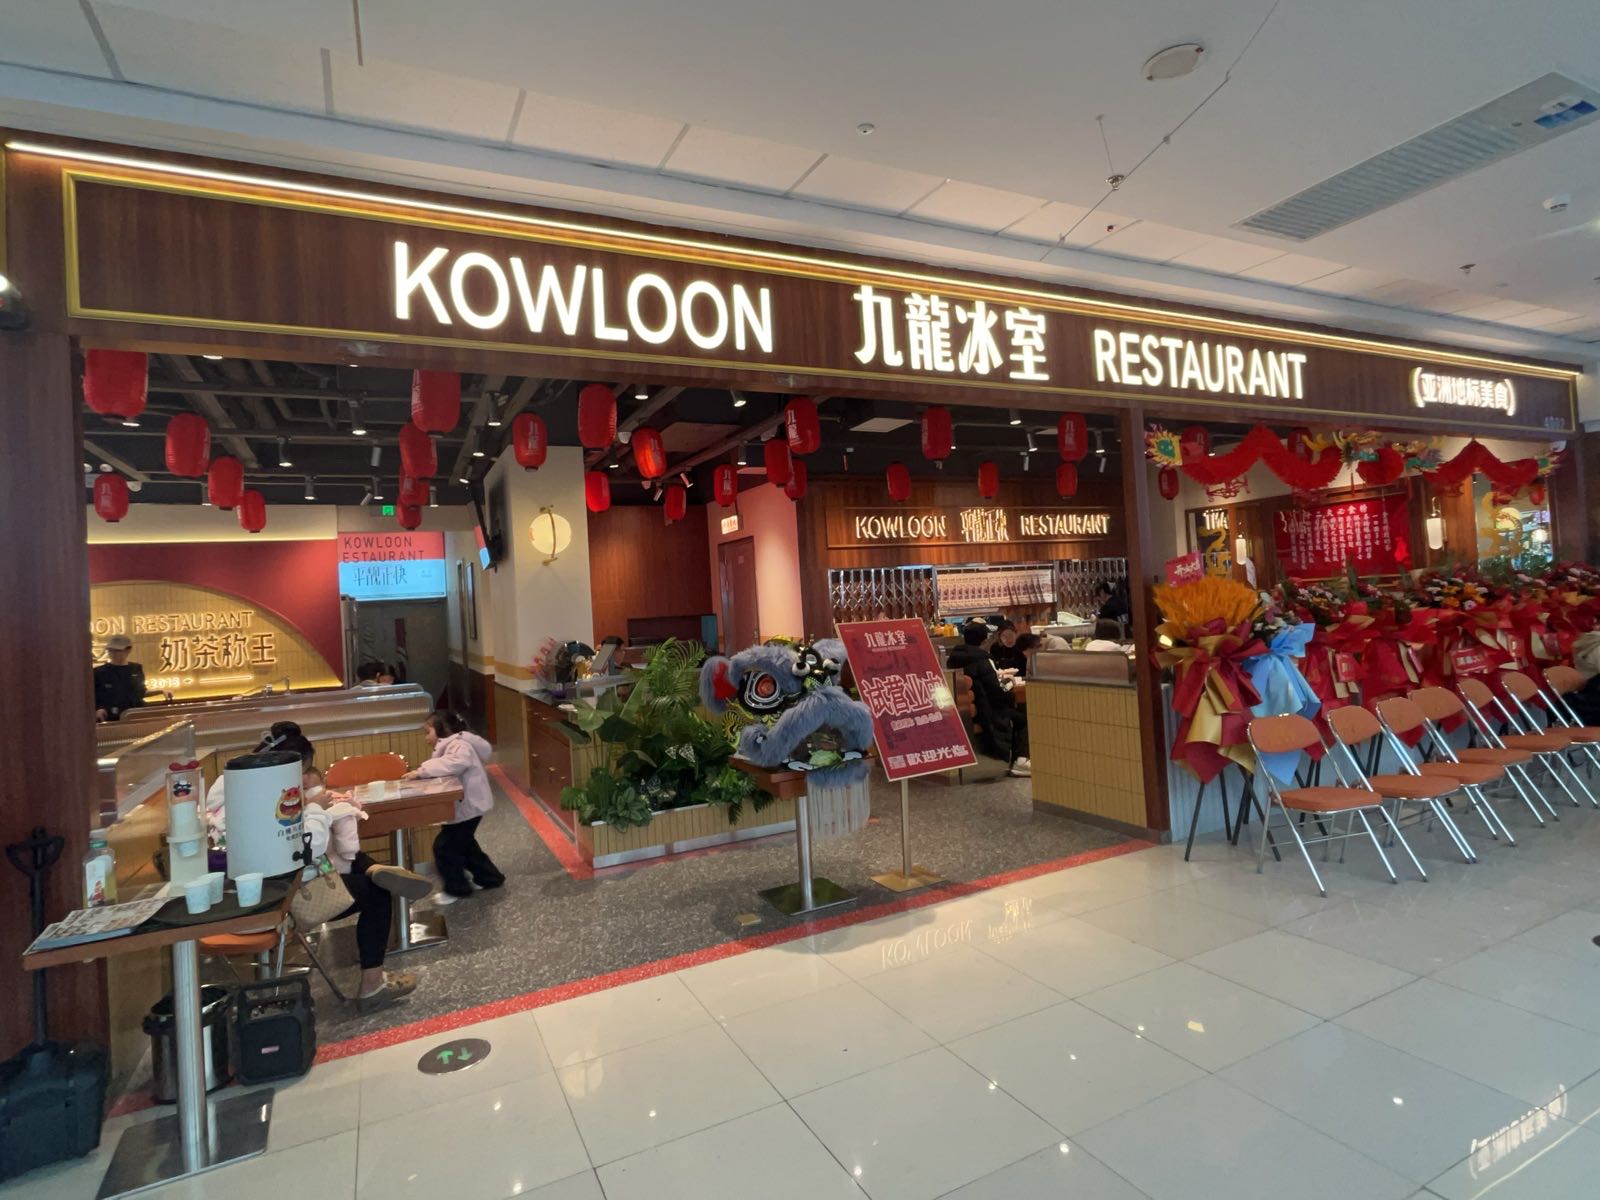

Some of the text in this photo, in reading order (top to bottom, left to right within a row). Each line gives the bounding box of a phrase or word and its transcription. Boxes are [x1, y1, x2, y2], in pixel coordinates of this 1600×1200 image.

[394, 241, 773, 353] KOWLOON
[853, 285, 1050, 381] 九龍冰室
[1093, 328, 1307, 399] RESTAURANT
[855, 515, 946, 539] KOWLOON
[1020, 514, 1111, 536] RESTAURANT
[344, 536, 412, 549] KOWLOON
[133, 611, 253, 635] RESTAURANT
[160, 633, 276, 672] 奶茶称王
